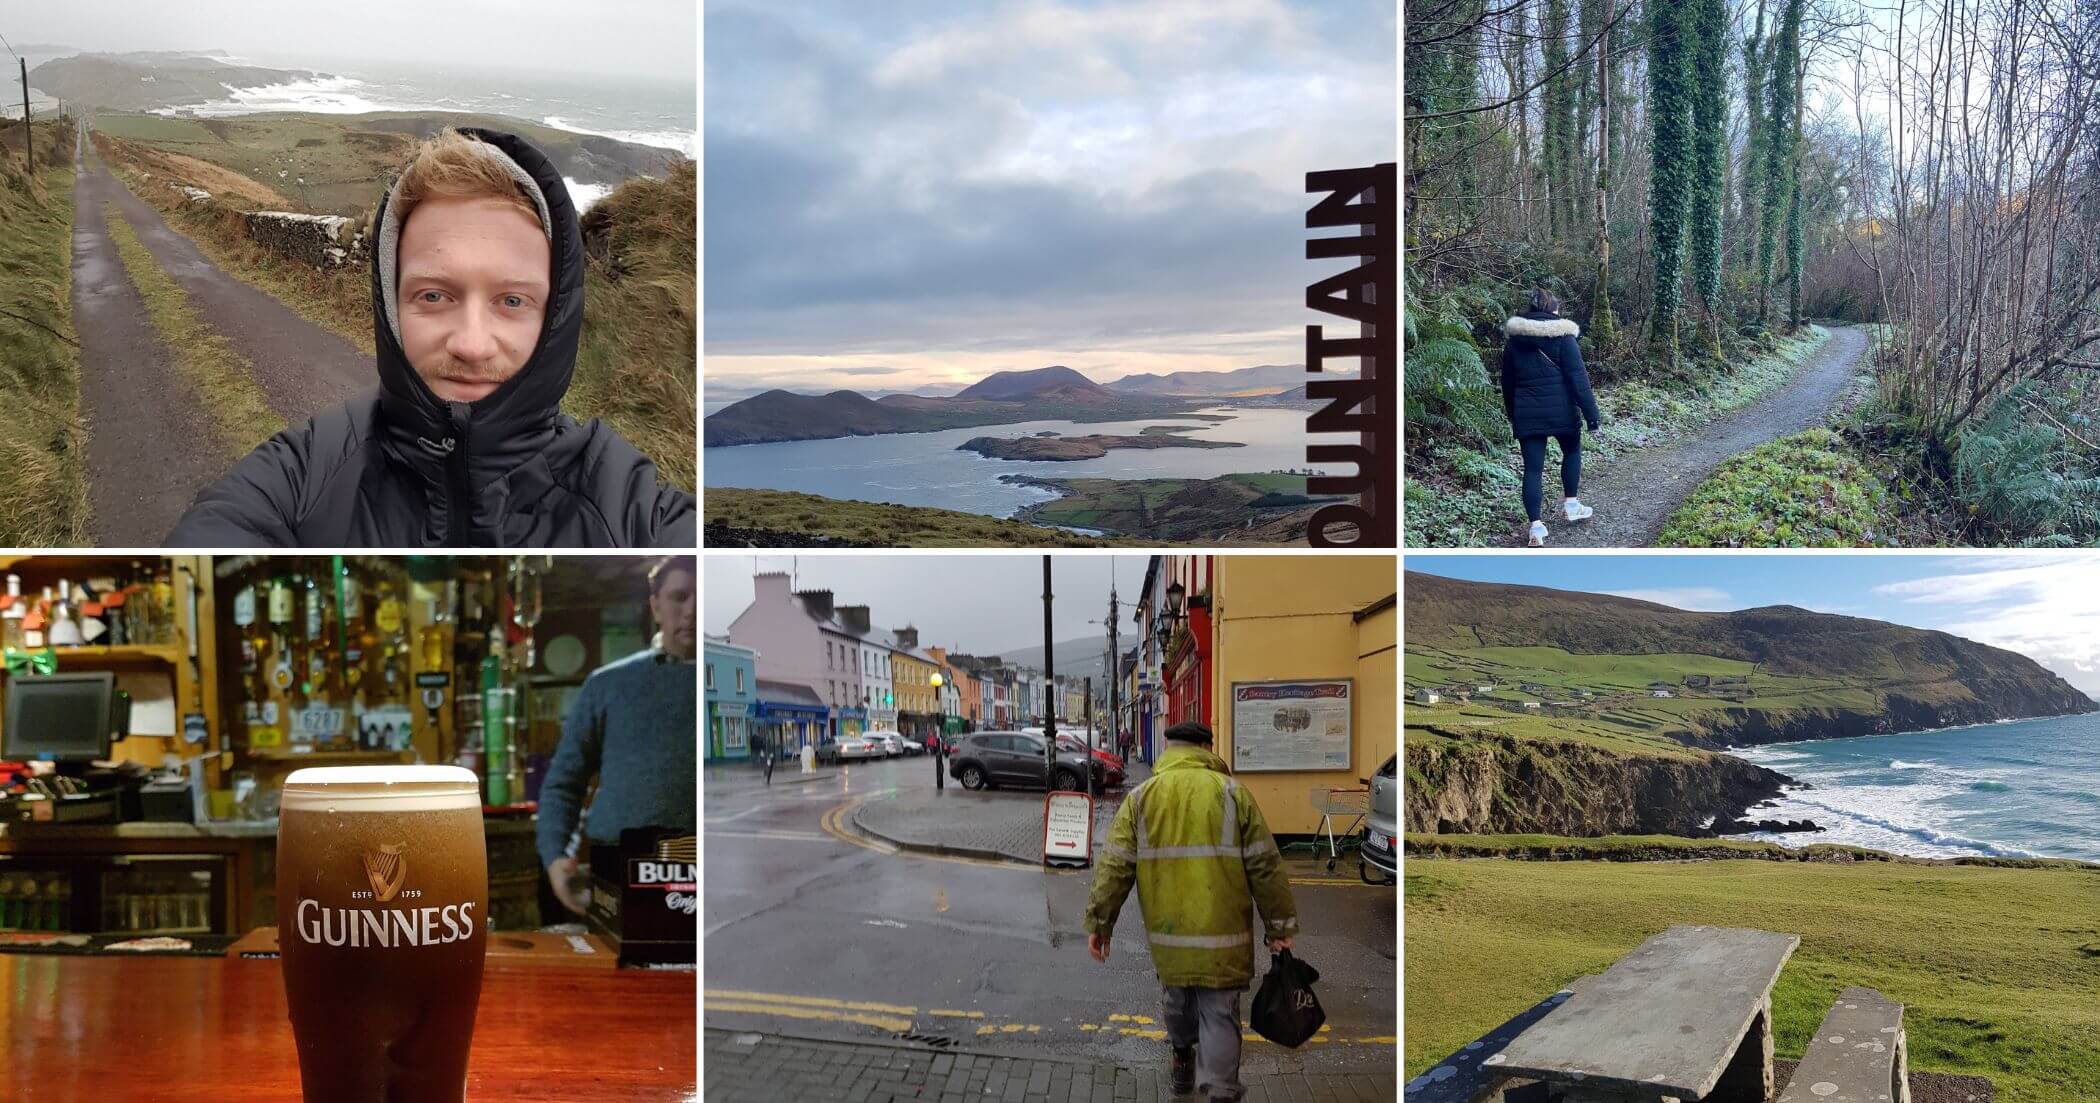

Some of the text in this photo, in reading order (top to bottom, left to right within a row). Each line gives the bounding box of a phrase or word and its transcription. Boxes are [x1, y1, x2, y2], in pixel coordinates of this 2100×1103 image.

[1306, 166, 1377, 548] OUNTAIN
[303, 710, 341, 730] 6287
[401, 890, 421, 898] 1759
[297, 899, 475, 948] GUINNESS
